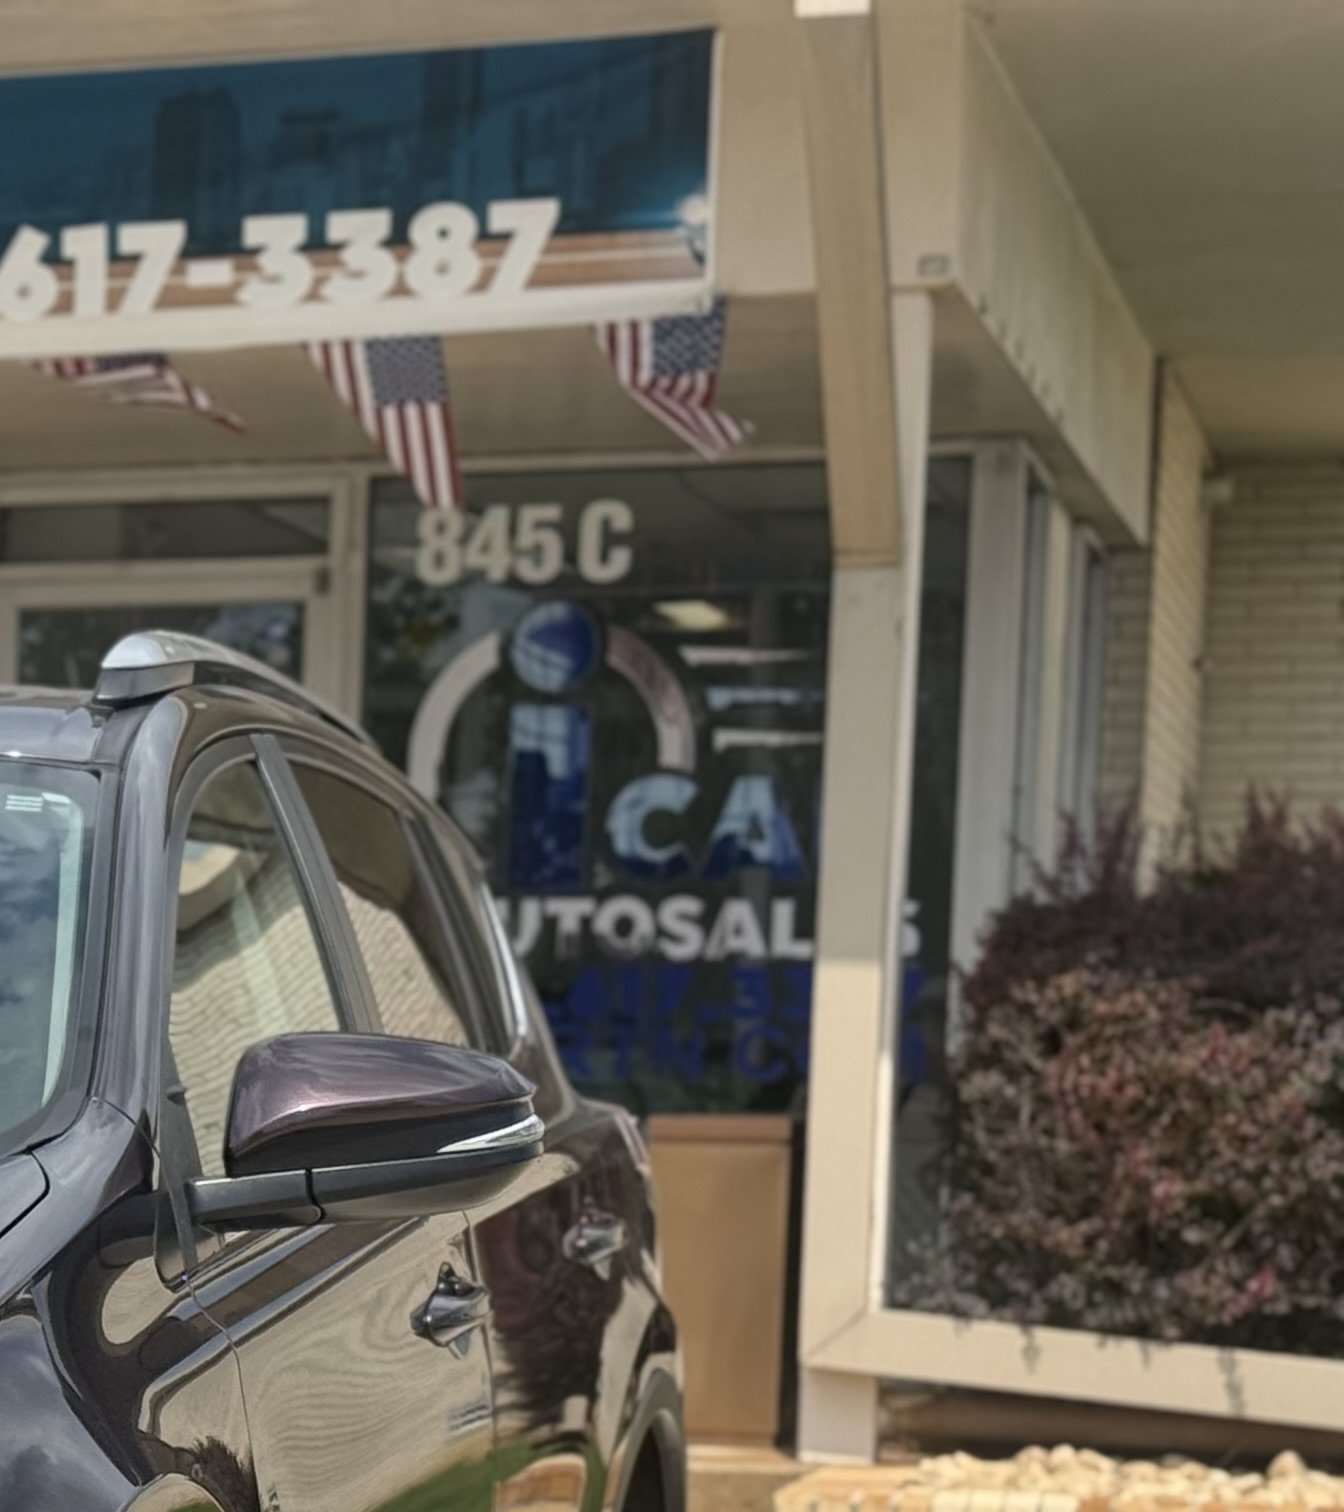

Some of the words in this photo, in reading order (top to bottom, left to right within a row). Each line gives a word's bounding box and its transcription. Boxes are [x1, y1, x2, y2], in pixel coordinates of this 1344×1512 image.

[415, 503, 565, 586] 845
[577, 499, 635, 583] C
[605, 772, 824, 881] CA
